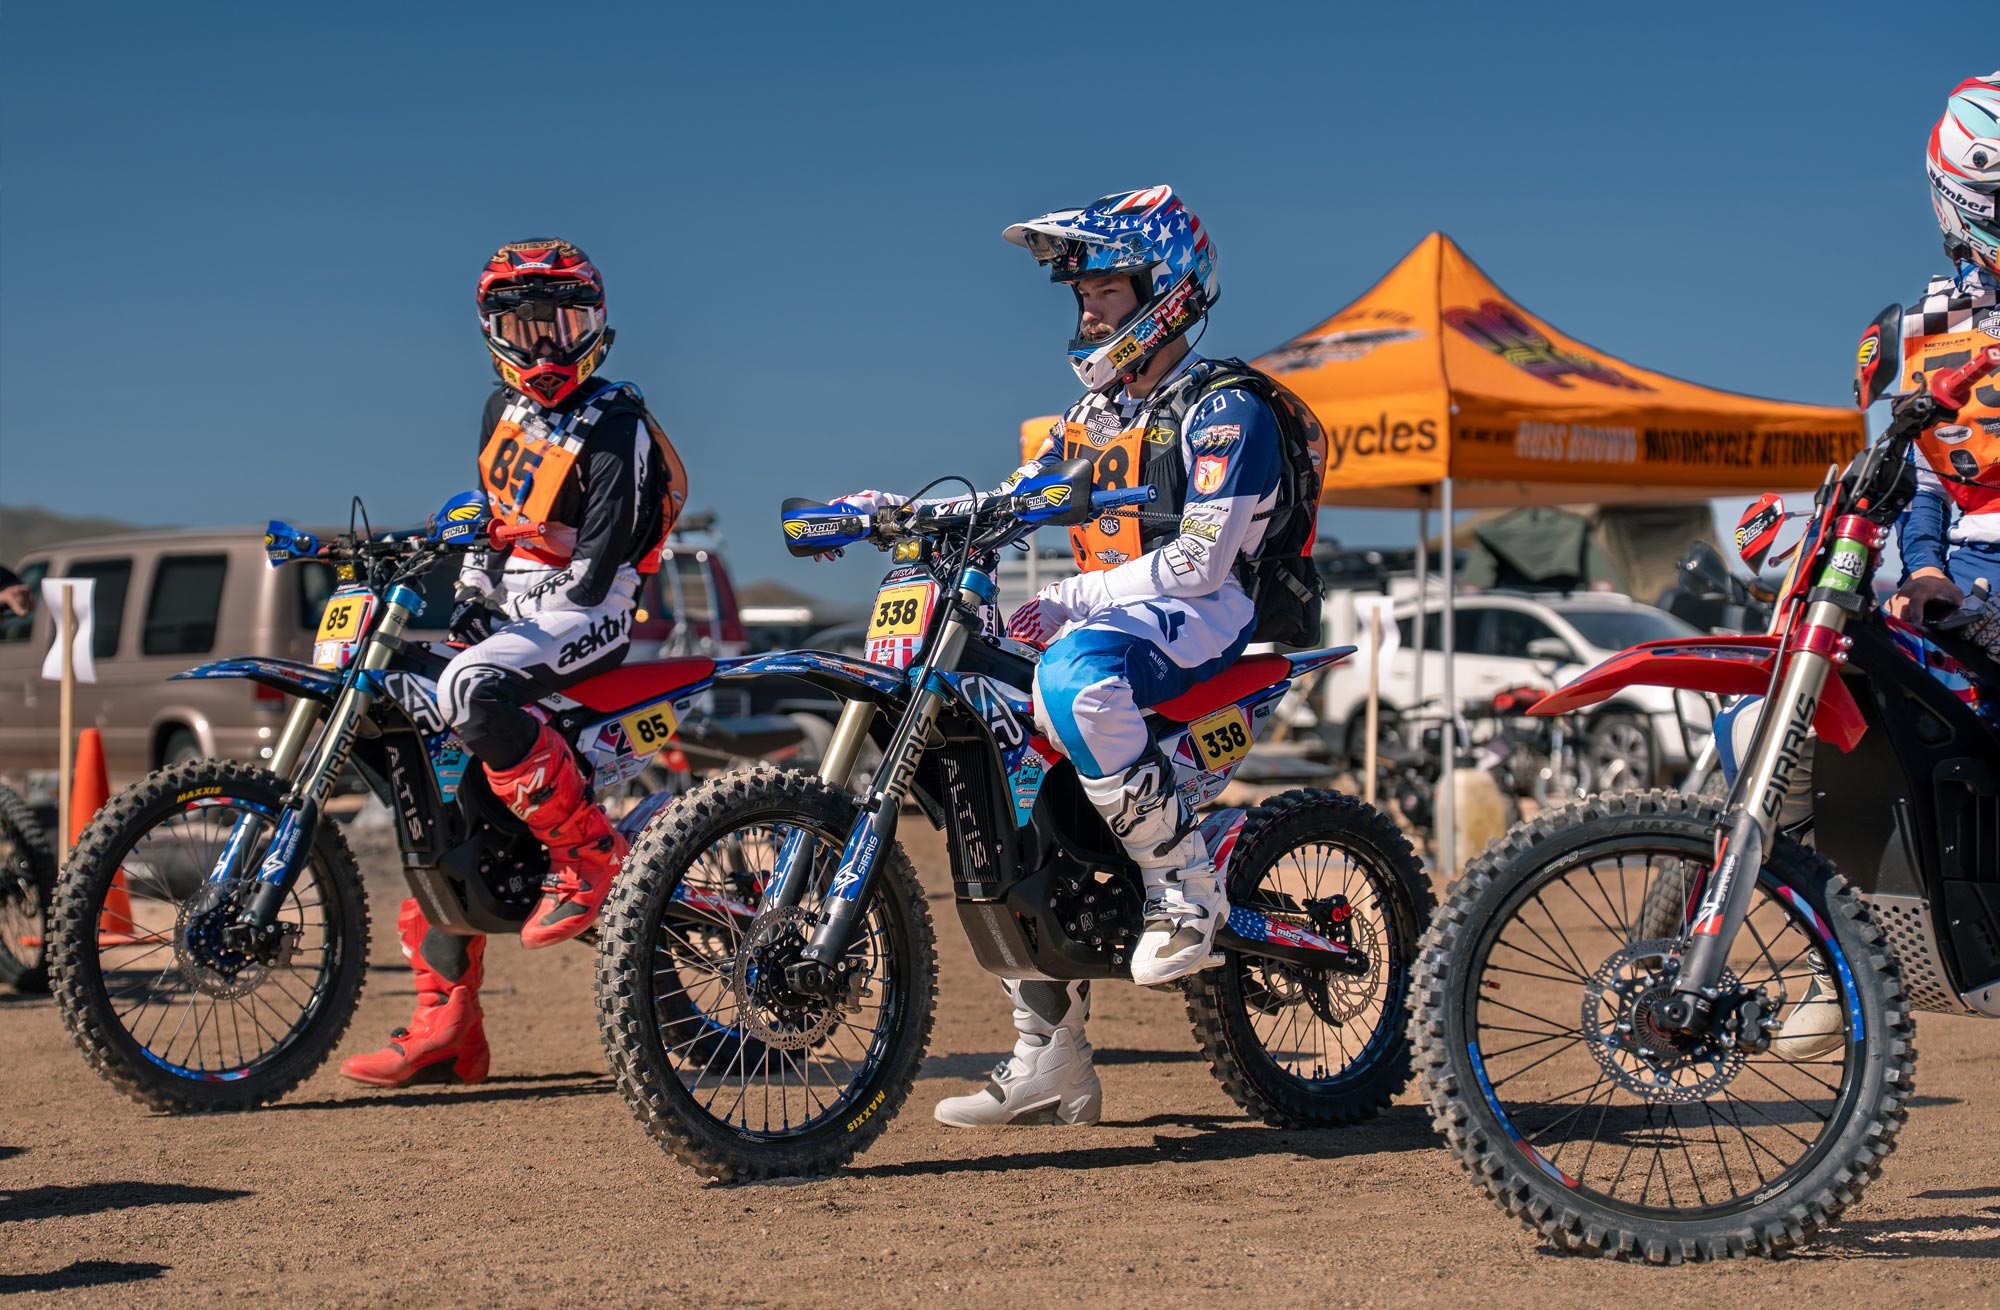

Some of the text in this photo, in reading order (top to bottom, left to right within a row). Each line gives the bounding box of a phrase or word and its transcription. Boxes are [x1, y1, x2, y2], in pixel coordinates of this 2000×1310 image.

[1929, 167, 1992, 214] Bomber
[1113, 342, 1137, 363] 338
[1925, 338, 1966, 348] METZELER
[581, 360, 592, 376] 85
[1330, 411, 1438, 470] ycles
[1645, 426, 1755, 467] MOTORCYCLE
[1759, 430, 1860, 467] ATTORNEYS
[489, 437, 543, 503] 85
[1027, 495, 1049, 508] CYCRA
[442, 524, 468, 541] CYCRA
[801, 521, 840, 534] CYCRA
[1100, 518, 1119, 530] 805
[890, 567, 919, 578] RITSON
[326, 605, 352, 632] 85
[876, 598, 919, 628] 338
[636, 713, 669, 744] 85
[1202, 721, 1247, 758] 338
[315, 711, 362, 802] SIRRIS
[886, 711, 933, 801] IRRIS
[1020, 764, 1040, 780] CRC
[1762, 692, 1817, 822] SIRRIS
[176, 785, 222, 804] MAXXIS
[385, 745, 425, 842] ALTIS
[940, 757, 991, 869] ALTIS
[281, 827, 301, 863] SIRRIS
[856, 834, 878, 875] SIRRIS
[847, 1089, 886, 1132] MAXXIS
